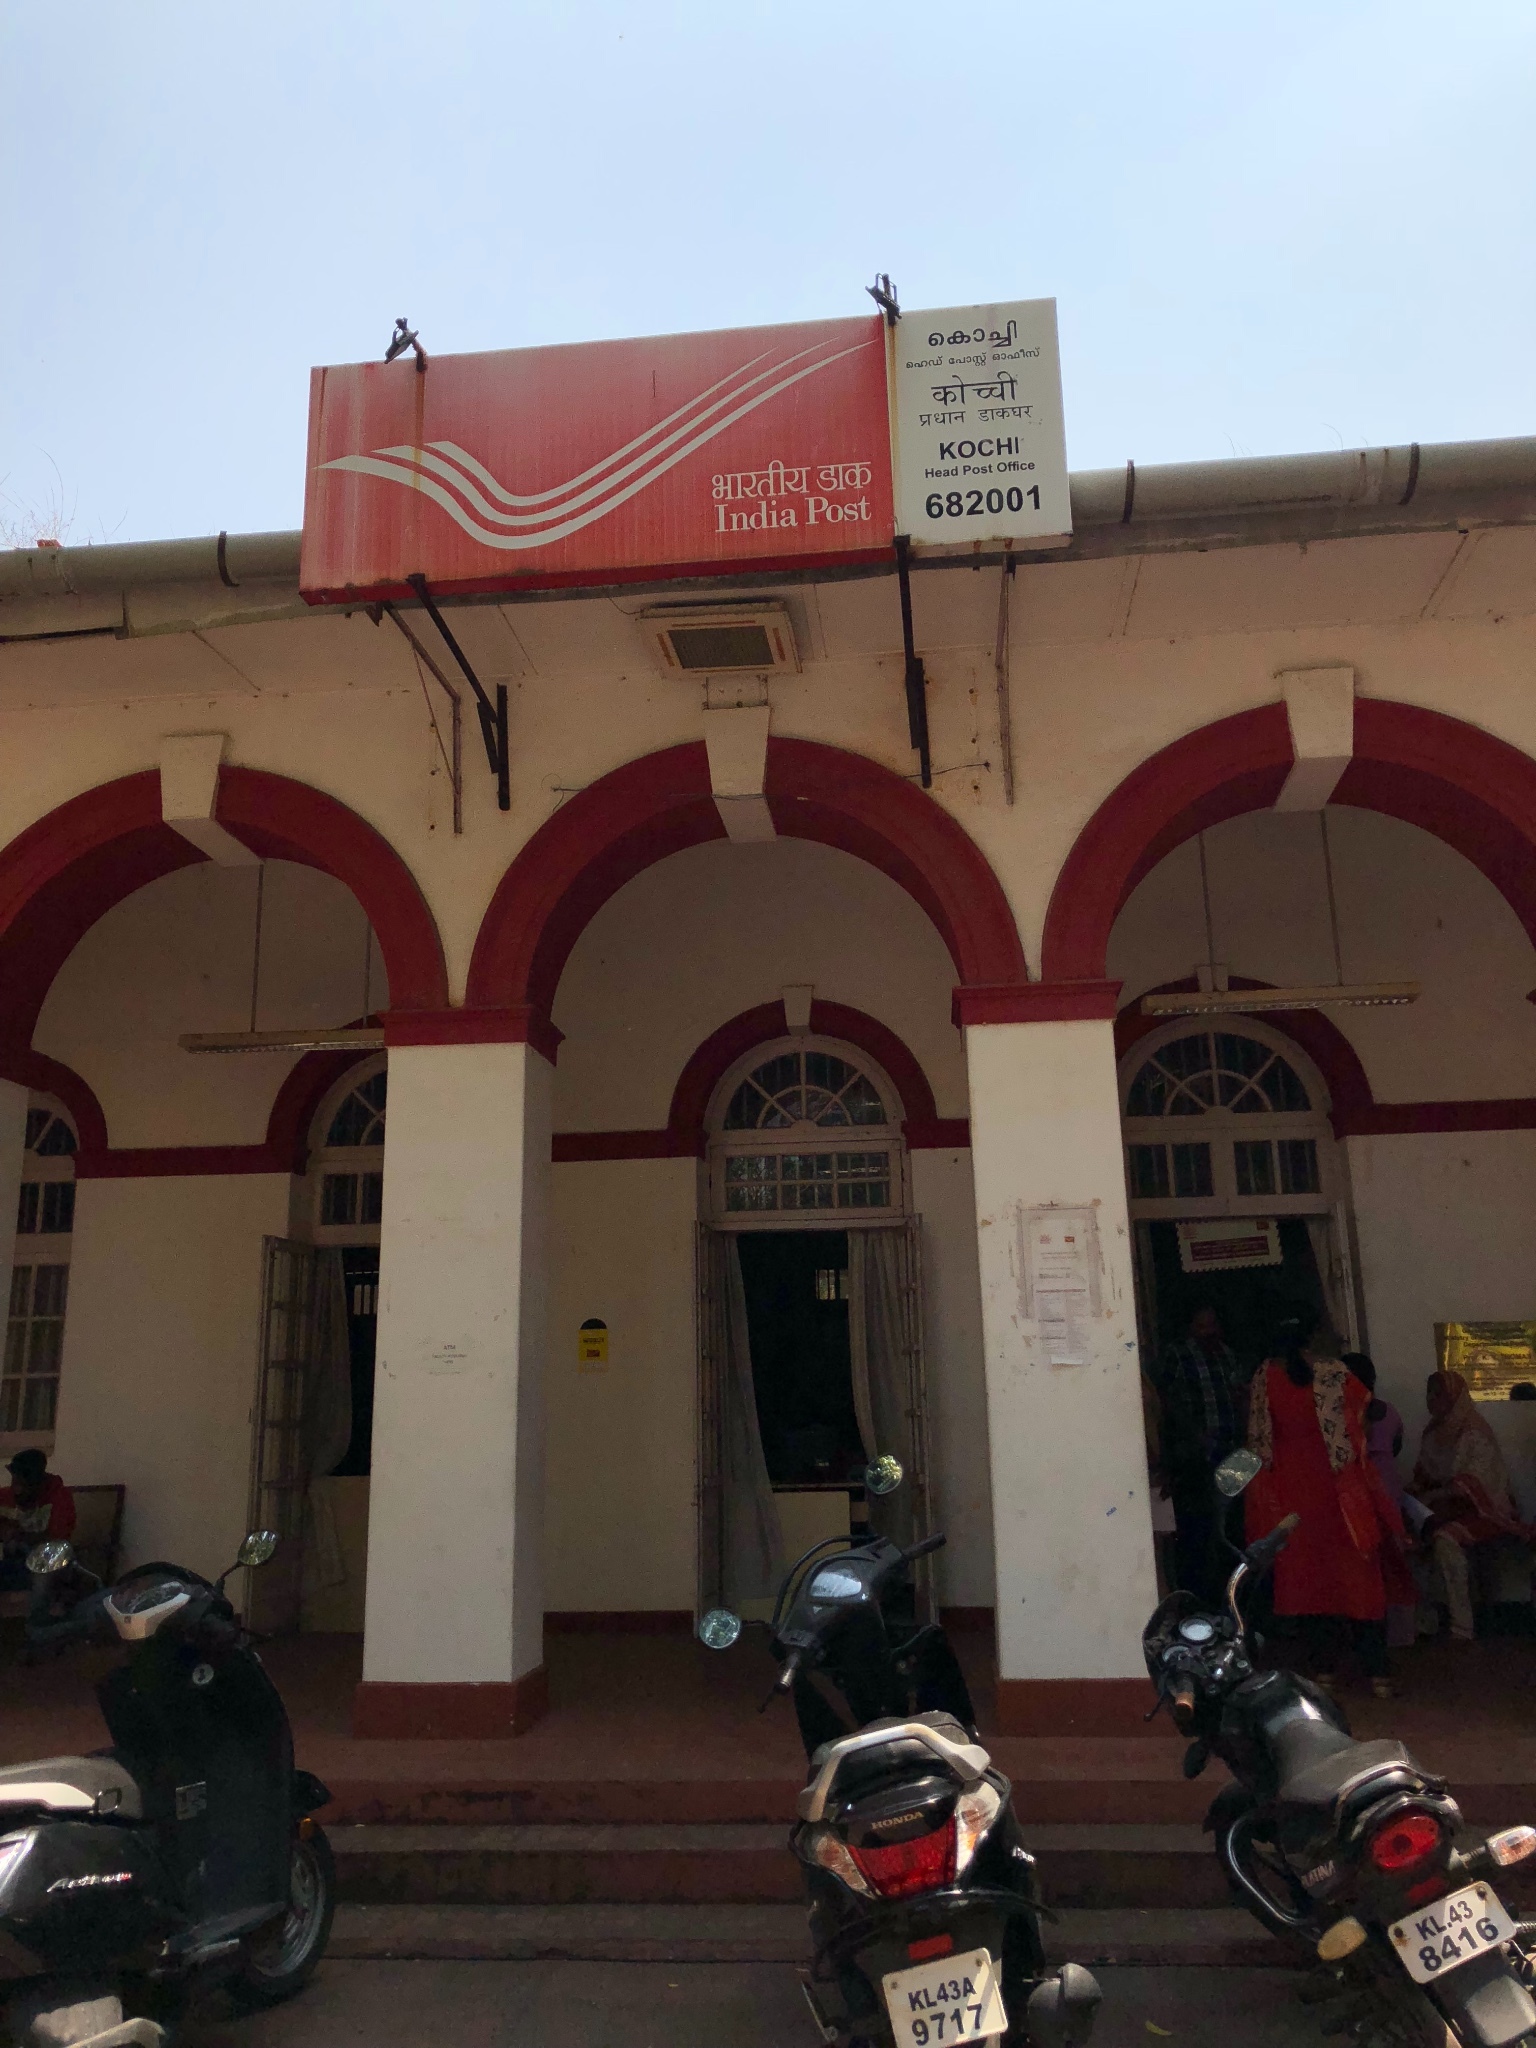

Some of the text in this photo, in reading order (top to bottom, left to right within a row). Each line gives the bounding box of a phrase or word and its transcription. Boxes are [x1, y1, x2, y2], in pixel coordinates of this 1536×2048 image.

[928, 319, 1018, 348] കൊച്ചി
[905, 355, 943, 369] ഹെഡ്
[918, 404, 1034, 427] प्रधान डाकघर
[939, 436, 1020, 461] KOCHI
[711, 459, 872, 500] भारतीय डाक
[924, 460, 1036, 479] Head Post Office
[714, 495, 872, 533] India Post
[925, 484, 1041, 519] 682001
[870, 1811, 925, 1831] HONDA
[1417, 1916, 1500, 1973] 8416
[907, 1976, 977, 2013] KL43A
[910, 2003, 984, 2046] 9717
